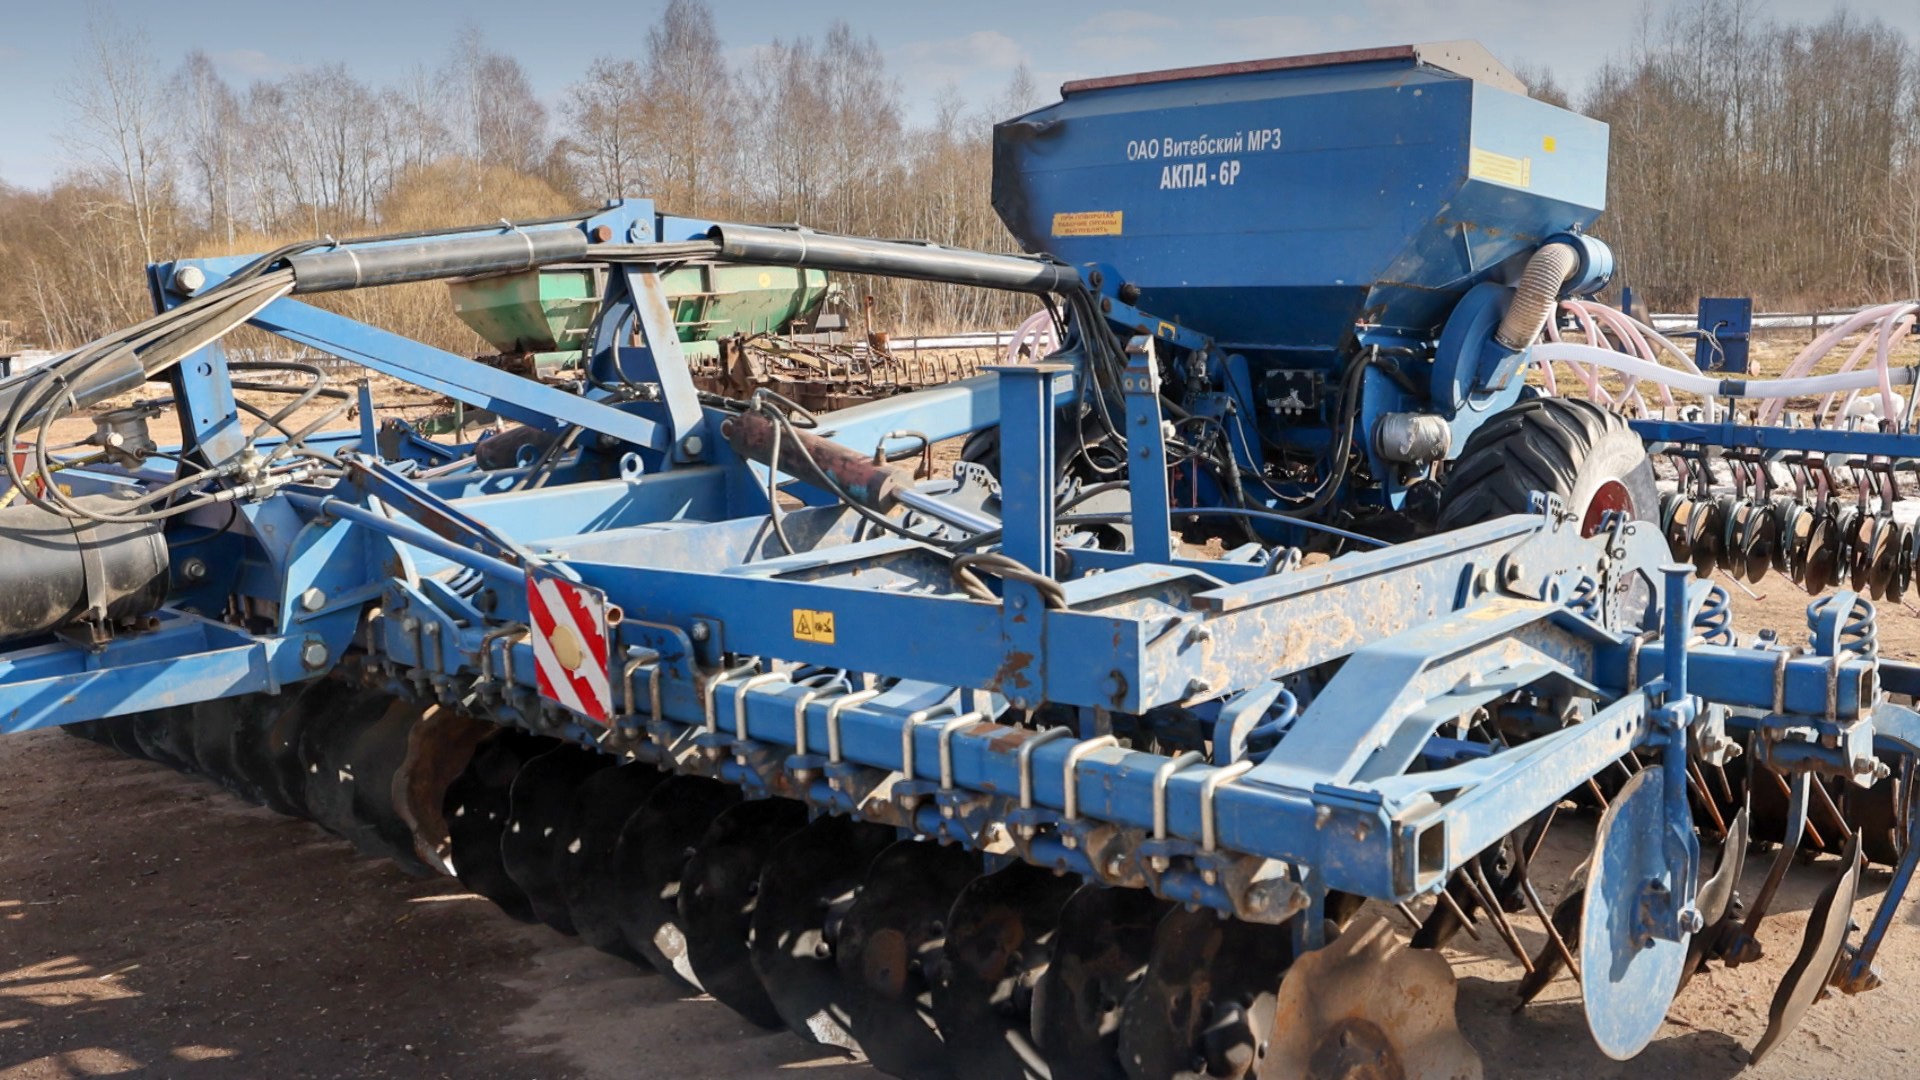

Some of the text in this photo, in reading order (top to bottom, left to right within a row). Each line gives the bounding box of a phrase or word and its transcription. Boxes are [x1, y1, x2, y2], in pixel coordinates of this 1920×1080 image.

[1127, 128, 1282, 161] ОАО Витебский МРЗ
[1160, 162, 1207, 190] АКПД
